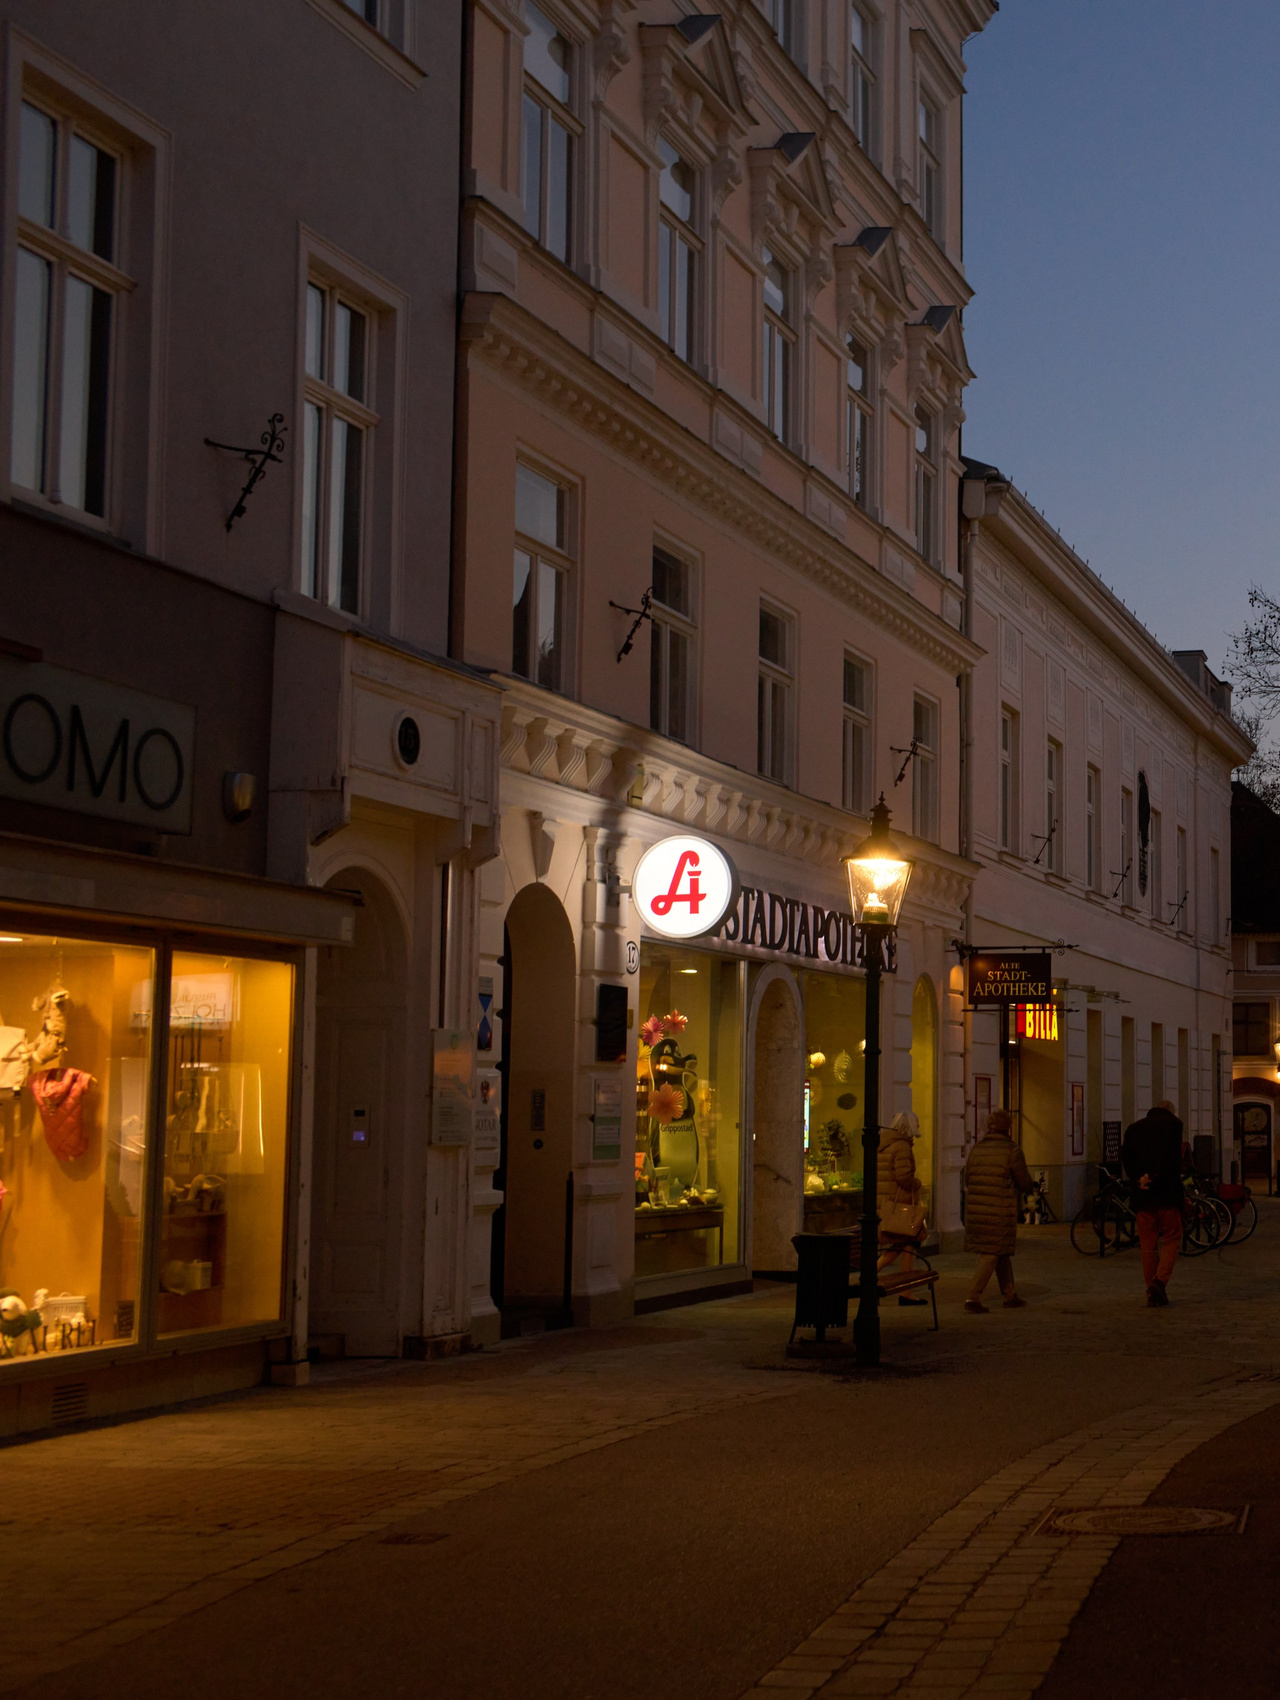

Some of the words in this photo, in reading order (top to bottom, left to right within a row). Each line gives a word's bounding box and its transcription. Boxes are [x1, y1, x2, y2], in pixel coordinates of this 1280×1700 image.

[725, 885, 898, 974] STADTAPOTHE
[628, 946, 636, 963] 17
[987, 970, 1031, 981] STADT-
[973, 982, 1047, 996] APOTHEKE
[1025, 1003, 1058, 1041] BILLA
